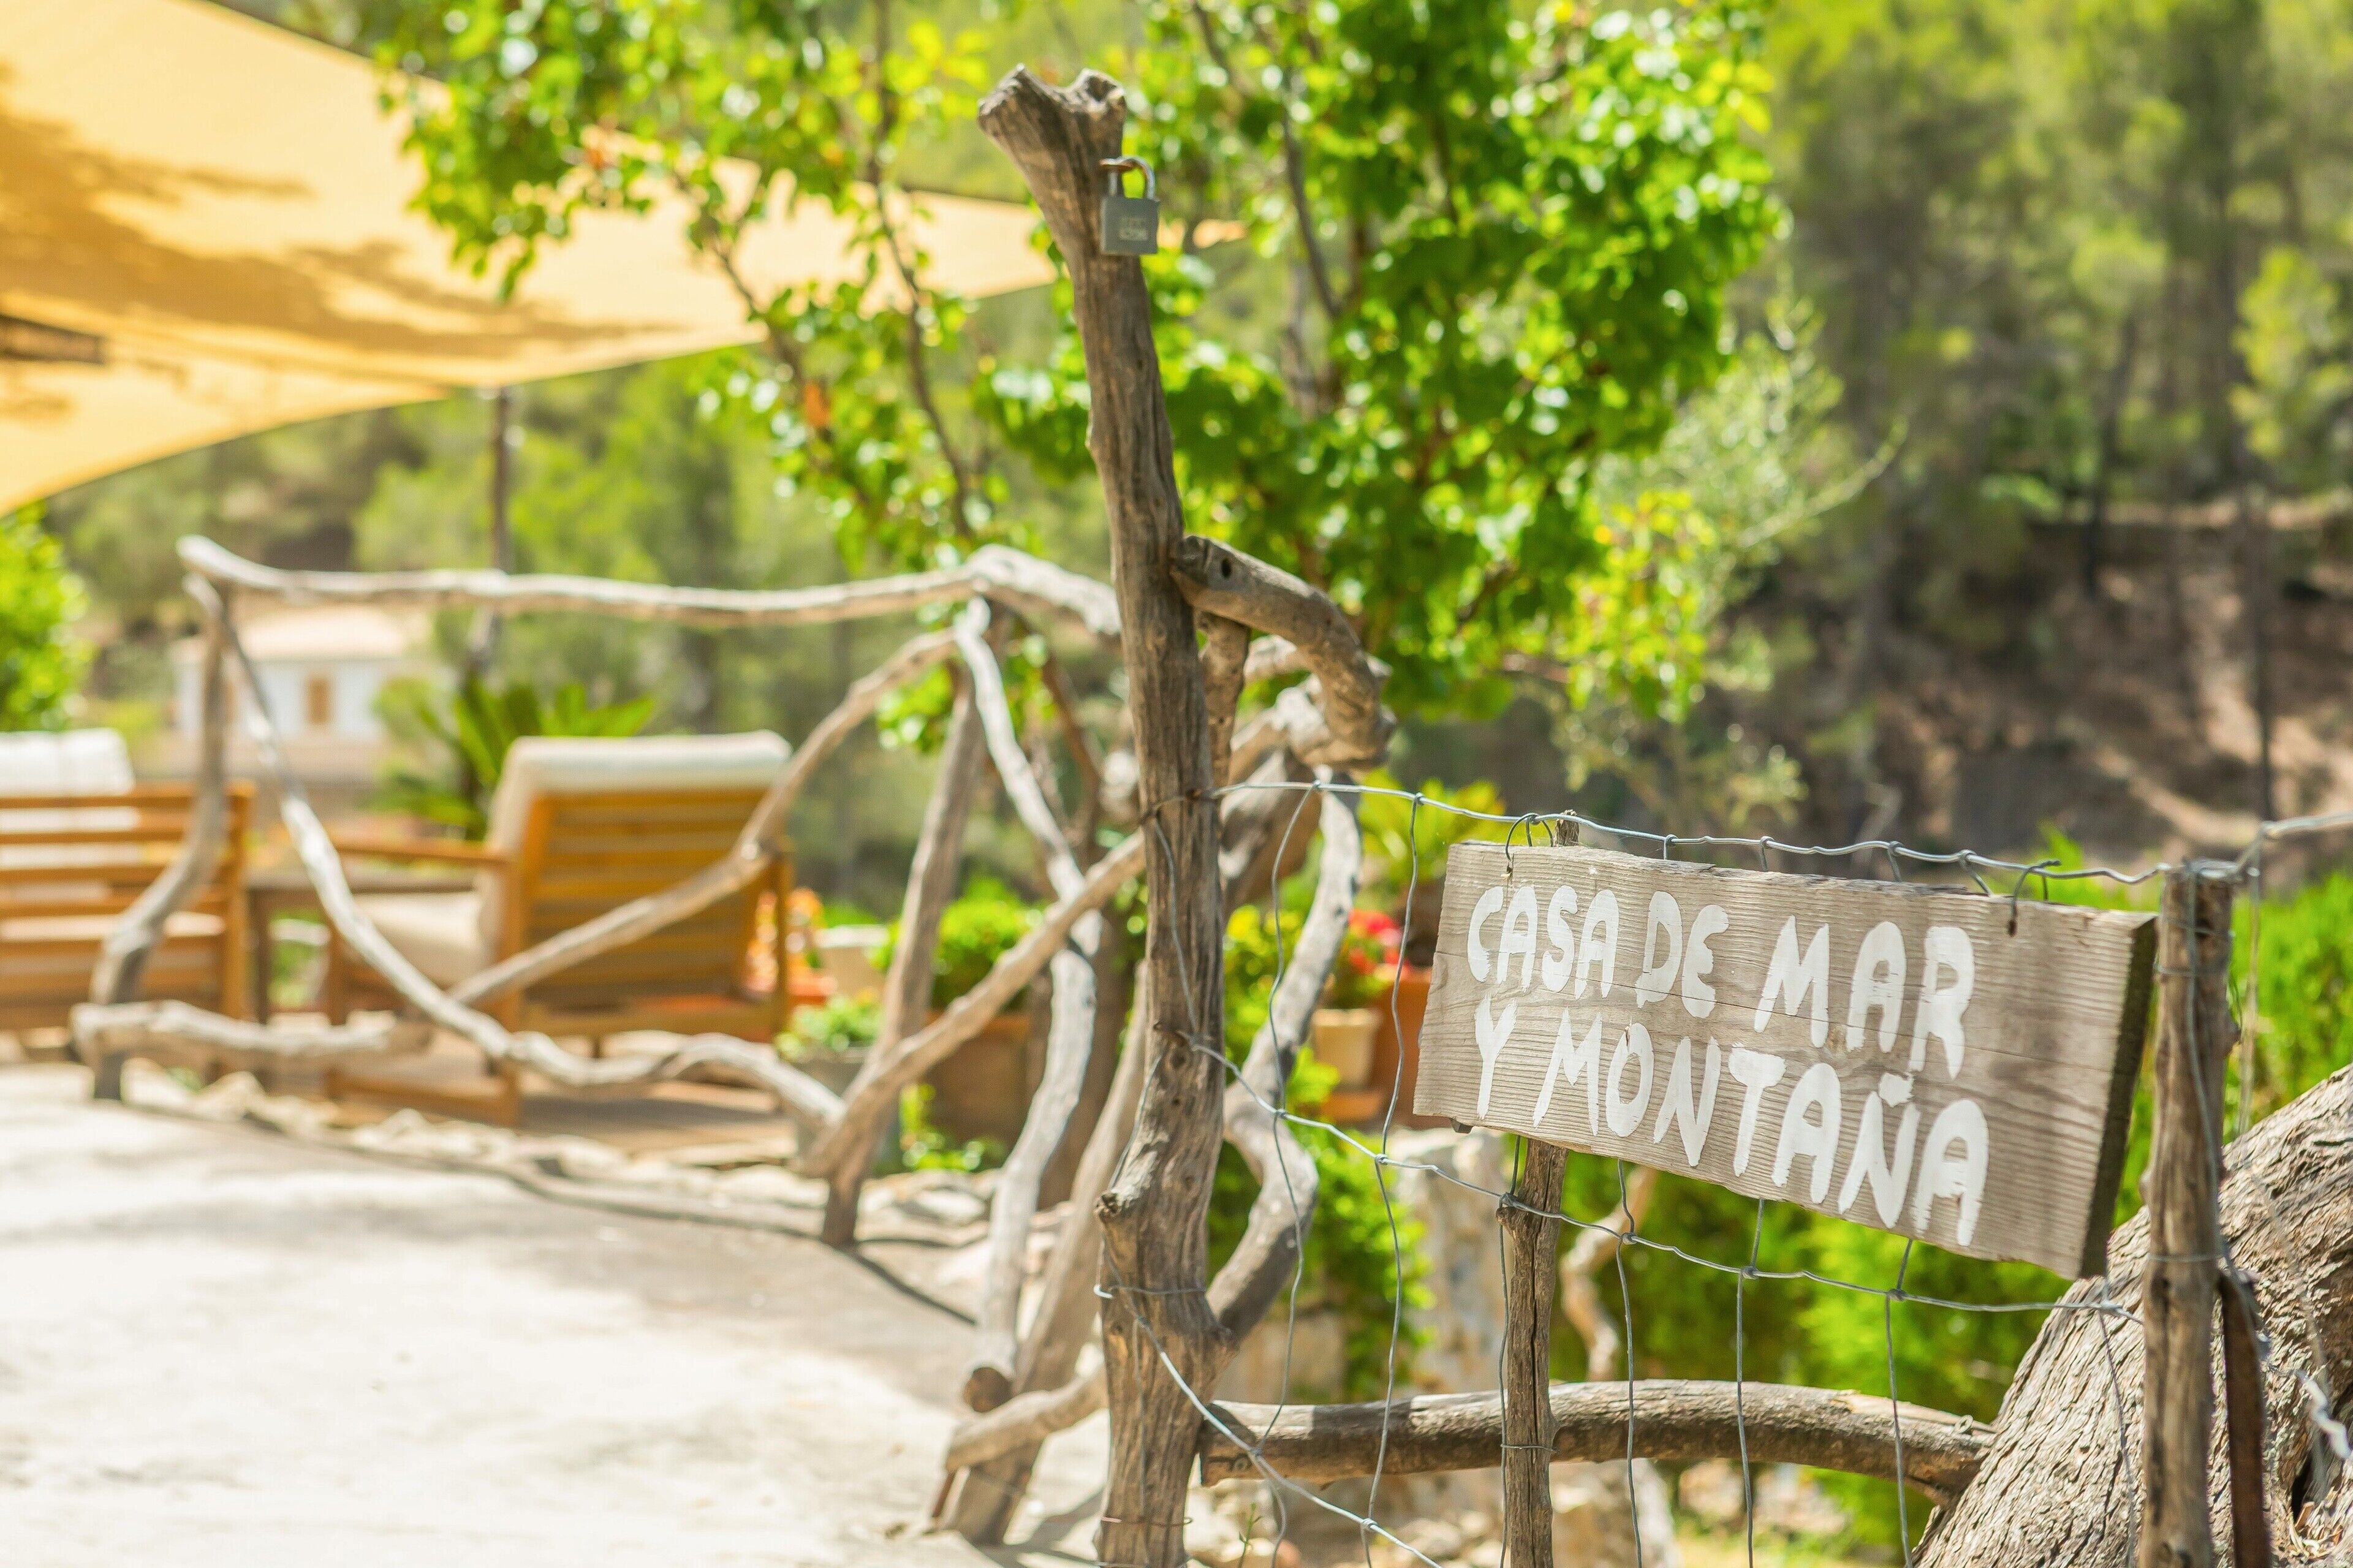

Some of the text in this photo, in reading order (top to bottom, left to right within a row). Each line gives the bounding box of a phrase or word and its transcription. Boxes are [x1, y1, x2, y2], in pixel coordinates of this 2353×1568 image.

[1467, 885, 1974, 1079] CASA DE MAR
[1474, 996, 1989, 1246] Y MONTAÑA
